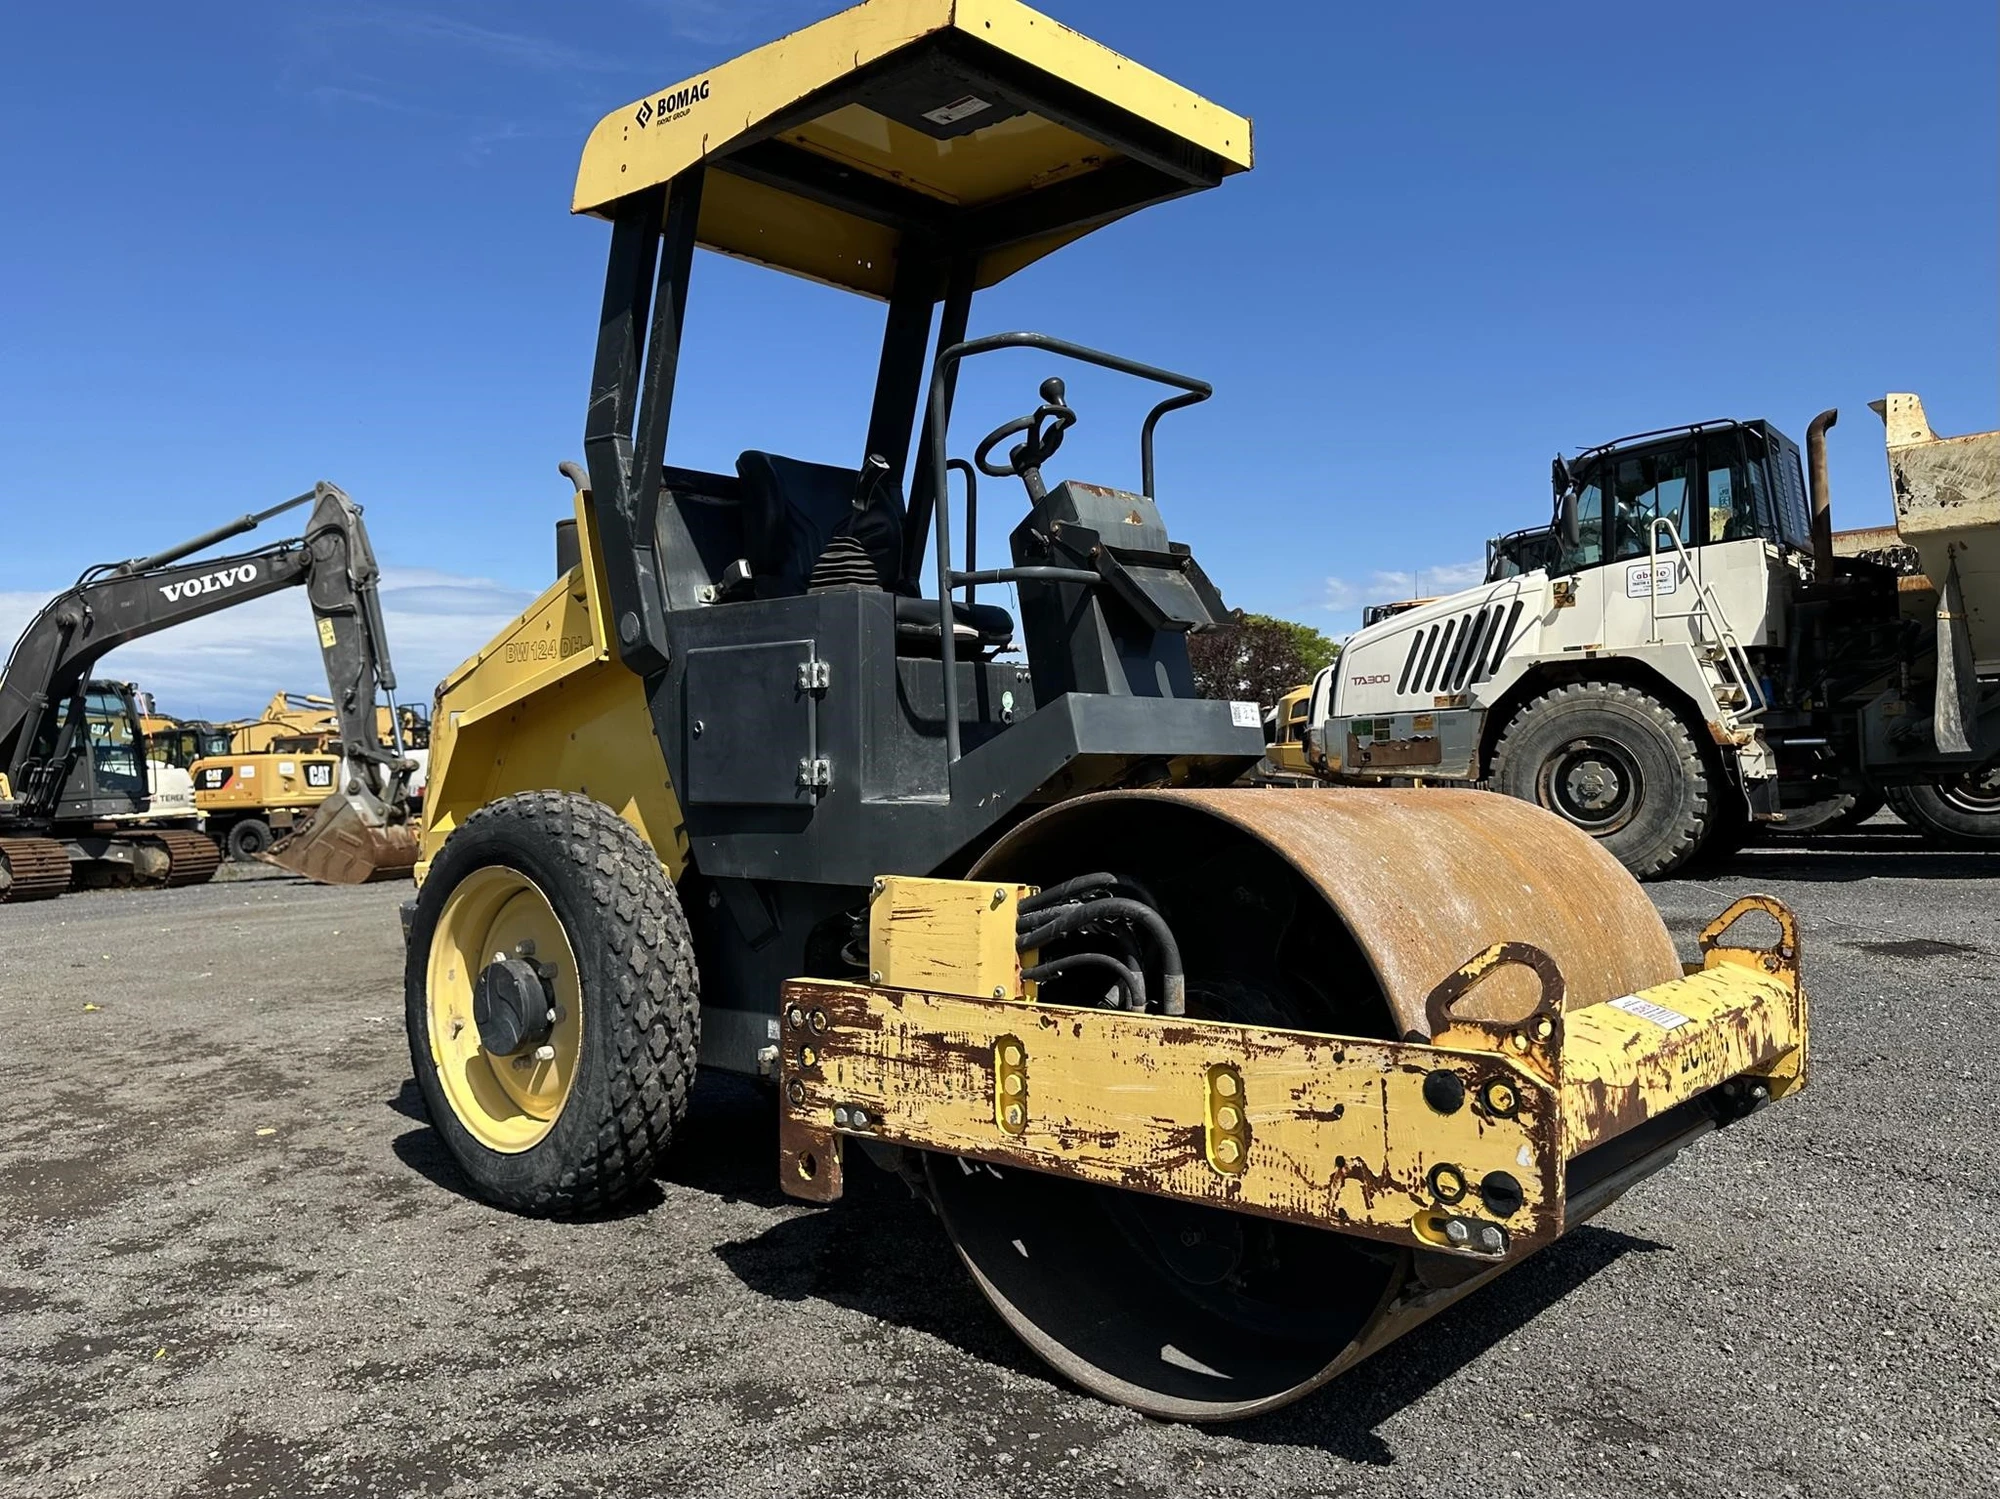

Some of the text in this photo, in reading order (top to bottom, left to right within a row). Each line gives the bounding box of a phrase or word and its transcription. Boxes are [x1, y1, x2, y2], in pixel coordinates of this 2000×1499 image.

[657, 79, 709, 118] BOMAG
[159, 564, 257, 602] VOLVO
[1351, 674, 1390, 686] TA300
[206, 769, 222, 781] CAT
[309, 765, 330, 786] CAT
